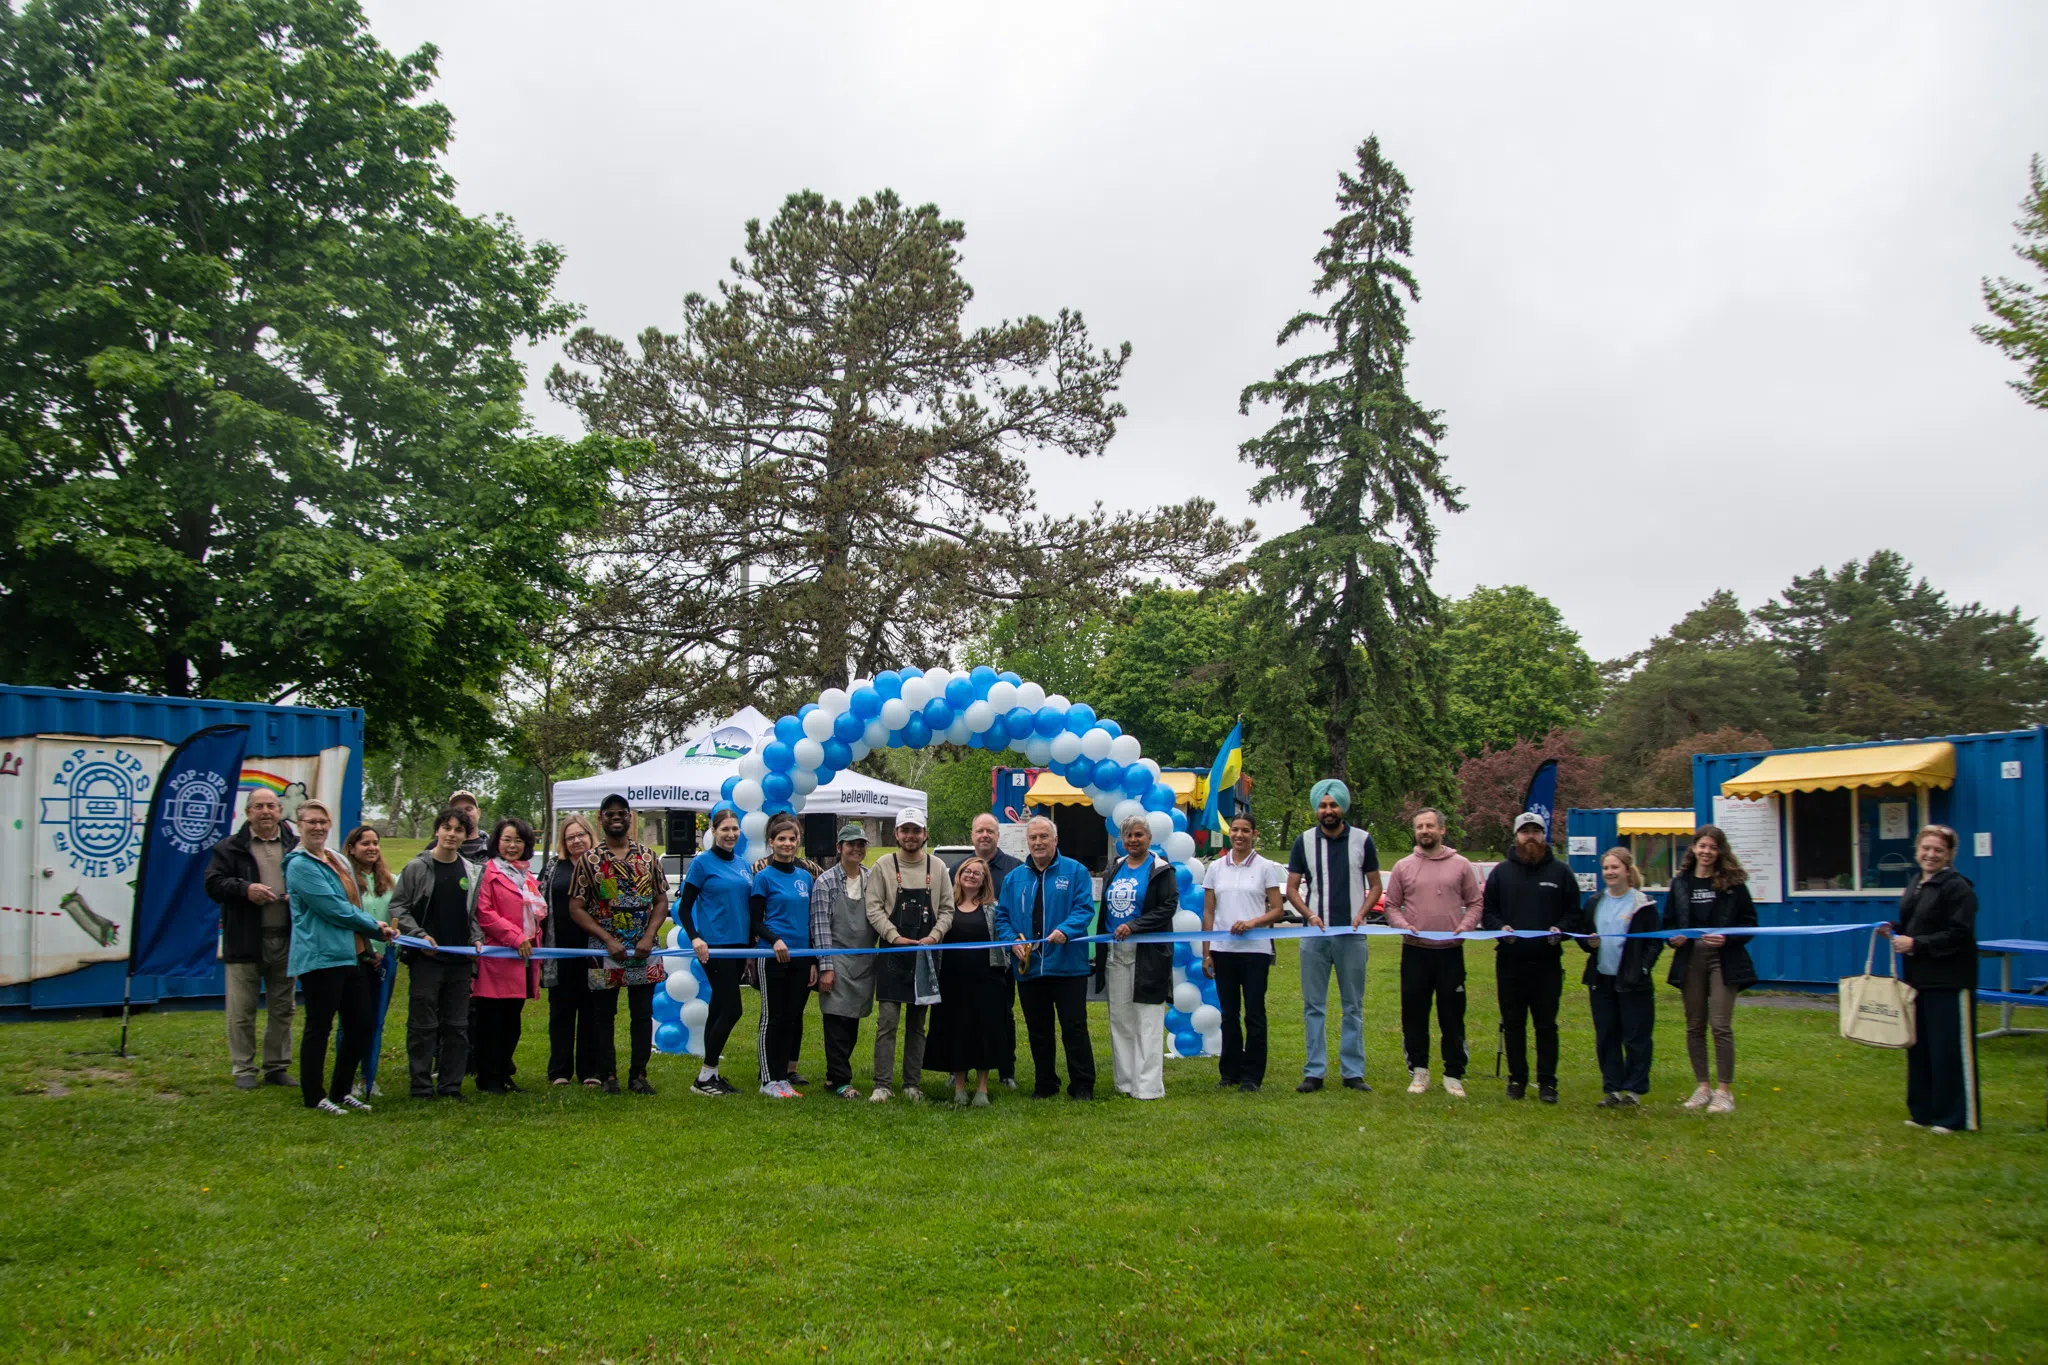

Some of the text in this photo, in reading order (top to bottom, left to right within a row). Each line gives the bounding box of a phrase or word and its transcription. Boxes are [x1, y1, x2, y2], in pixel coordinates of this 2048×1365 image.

[1016, 777, 1022, 786] 2
[627, 786, 710, 801] belleville.ca
[840, 789, 889, 805] belleville.ca
[169, 835, 200, 854] THE
[201, 828, 222, 851] BAY
[69, 851, 110, 878] THE
[112, 833, 143, 874] BAY
